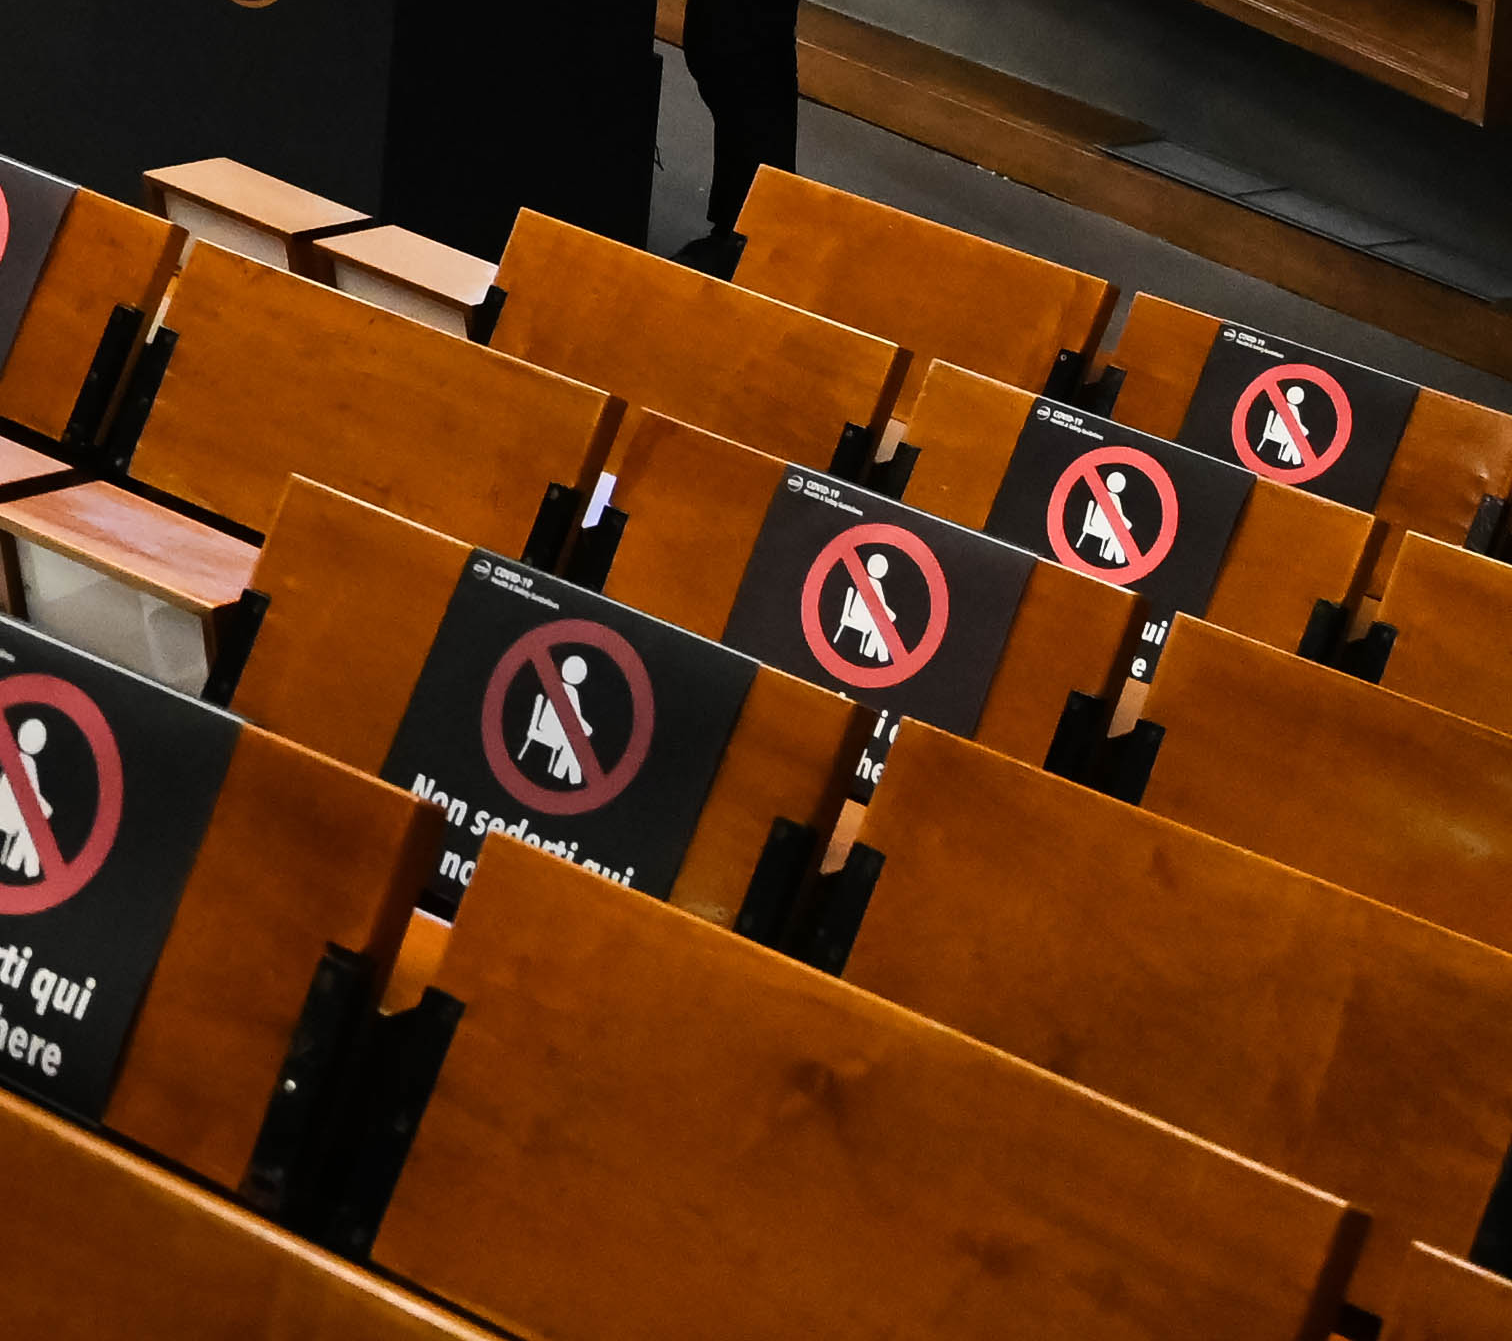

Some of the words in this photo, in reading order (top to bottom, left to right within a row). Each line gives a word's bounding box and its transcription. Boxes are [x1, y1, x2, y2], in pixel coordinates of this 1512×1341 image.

[1053, 410, 1083, 427] COVID-19
[806, 480, 840, 499] COVID-19
[494, 566, 533, 589] COVID-19
[30, 967, 96, 1019] qui
